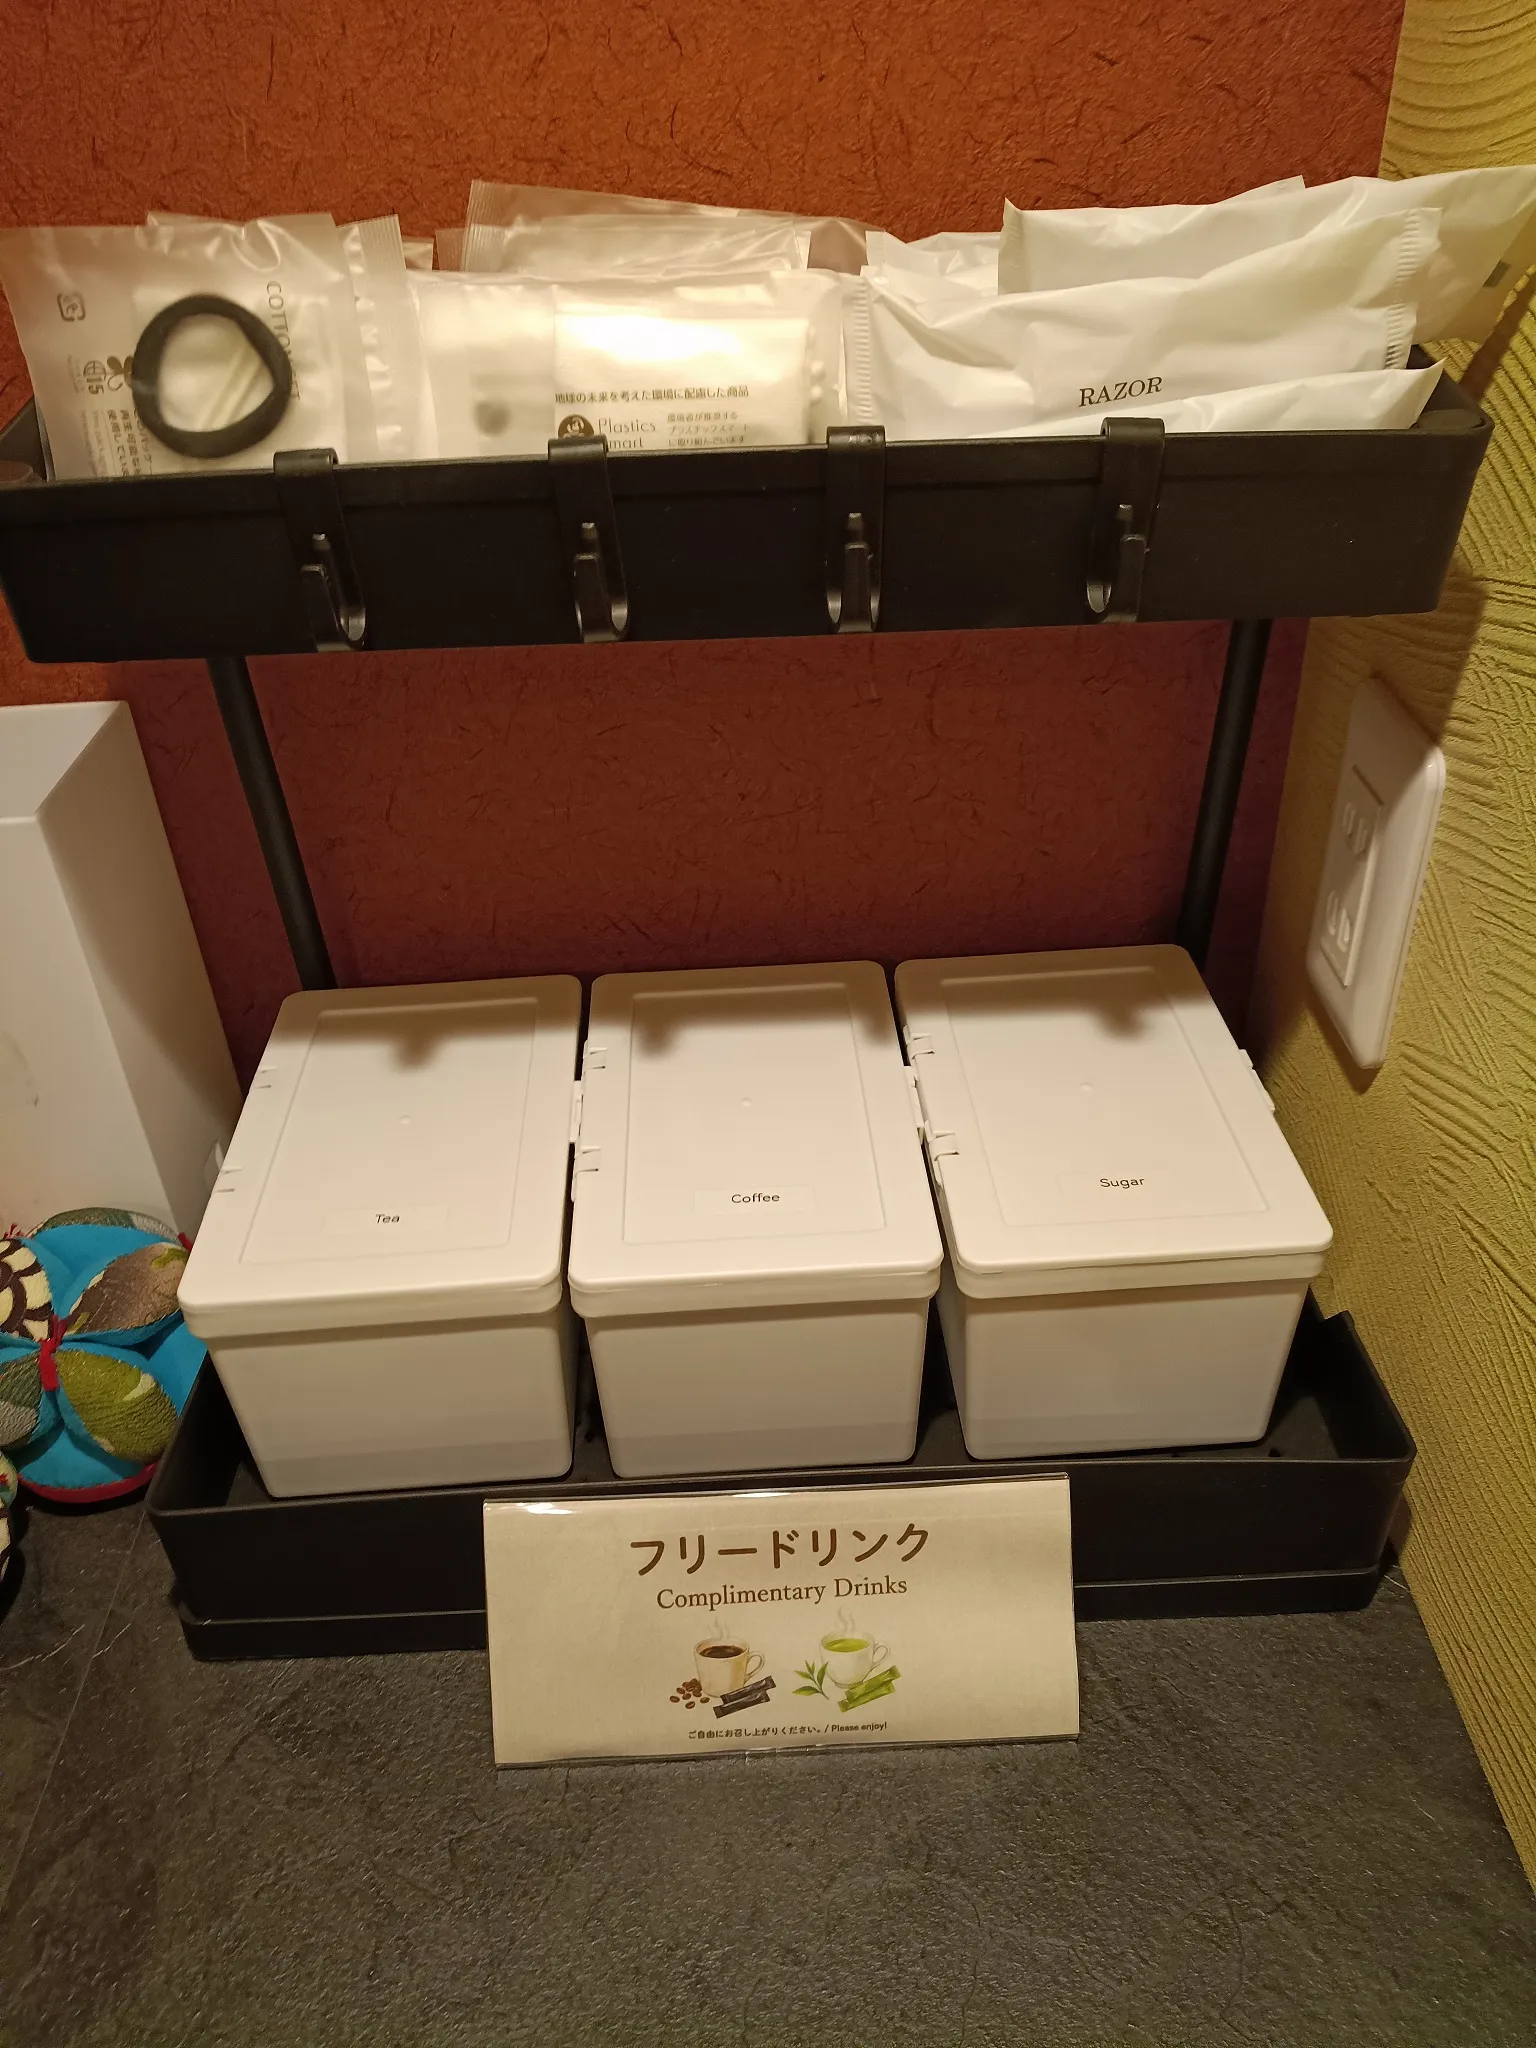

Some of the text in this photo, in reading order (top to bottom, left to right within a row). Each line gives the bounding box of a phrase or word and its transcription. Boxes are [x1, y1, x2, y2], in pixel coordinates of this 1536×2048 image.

[266, 281, 292, 362] COTTO
[1079, 376, 1163, 407] RAZOR
[598, 416, 656, 433] Plastics
[608, 437, 643, 449] mart
[1099, 1177, 1145, 1189] Sugar
[731, 1192, 780, 1203] Coffee
[375, 1213, 400, 1224] Tea
[630, 1523, 928, 1576] フリードリンク
[656, 1574, 908, 1612] Complimentary Drinks
[688, 1725, 821, 1739] ご自由にお召し上がりください。
[831, 1723, 860, 1732] Please
[860, 1721, 887, 1731] enjoy!
